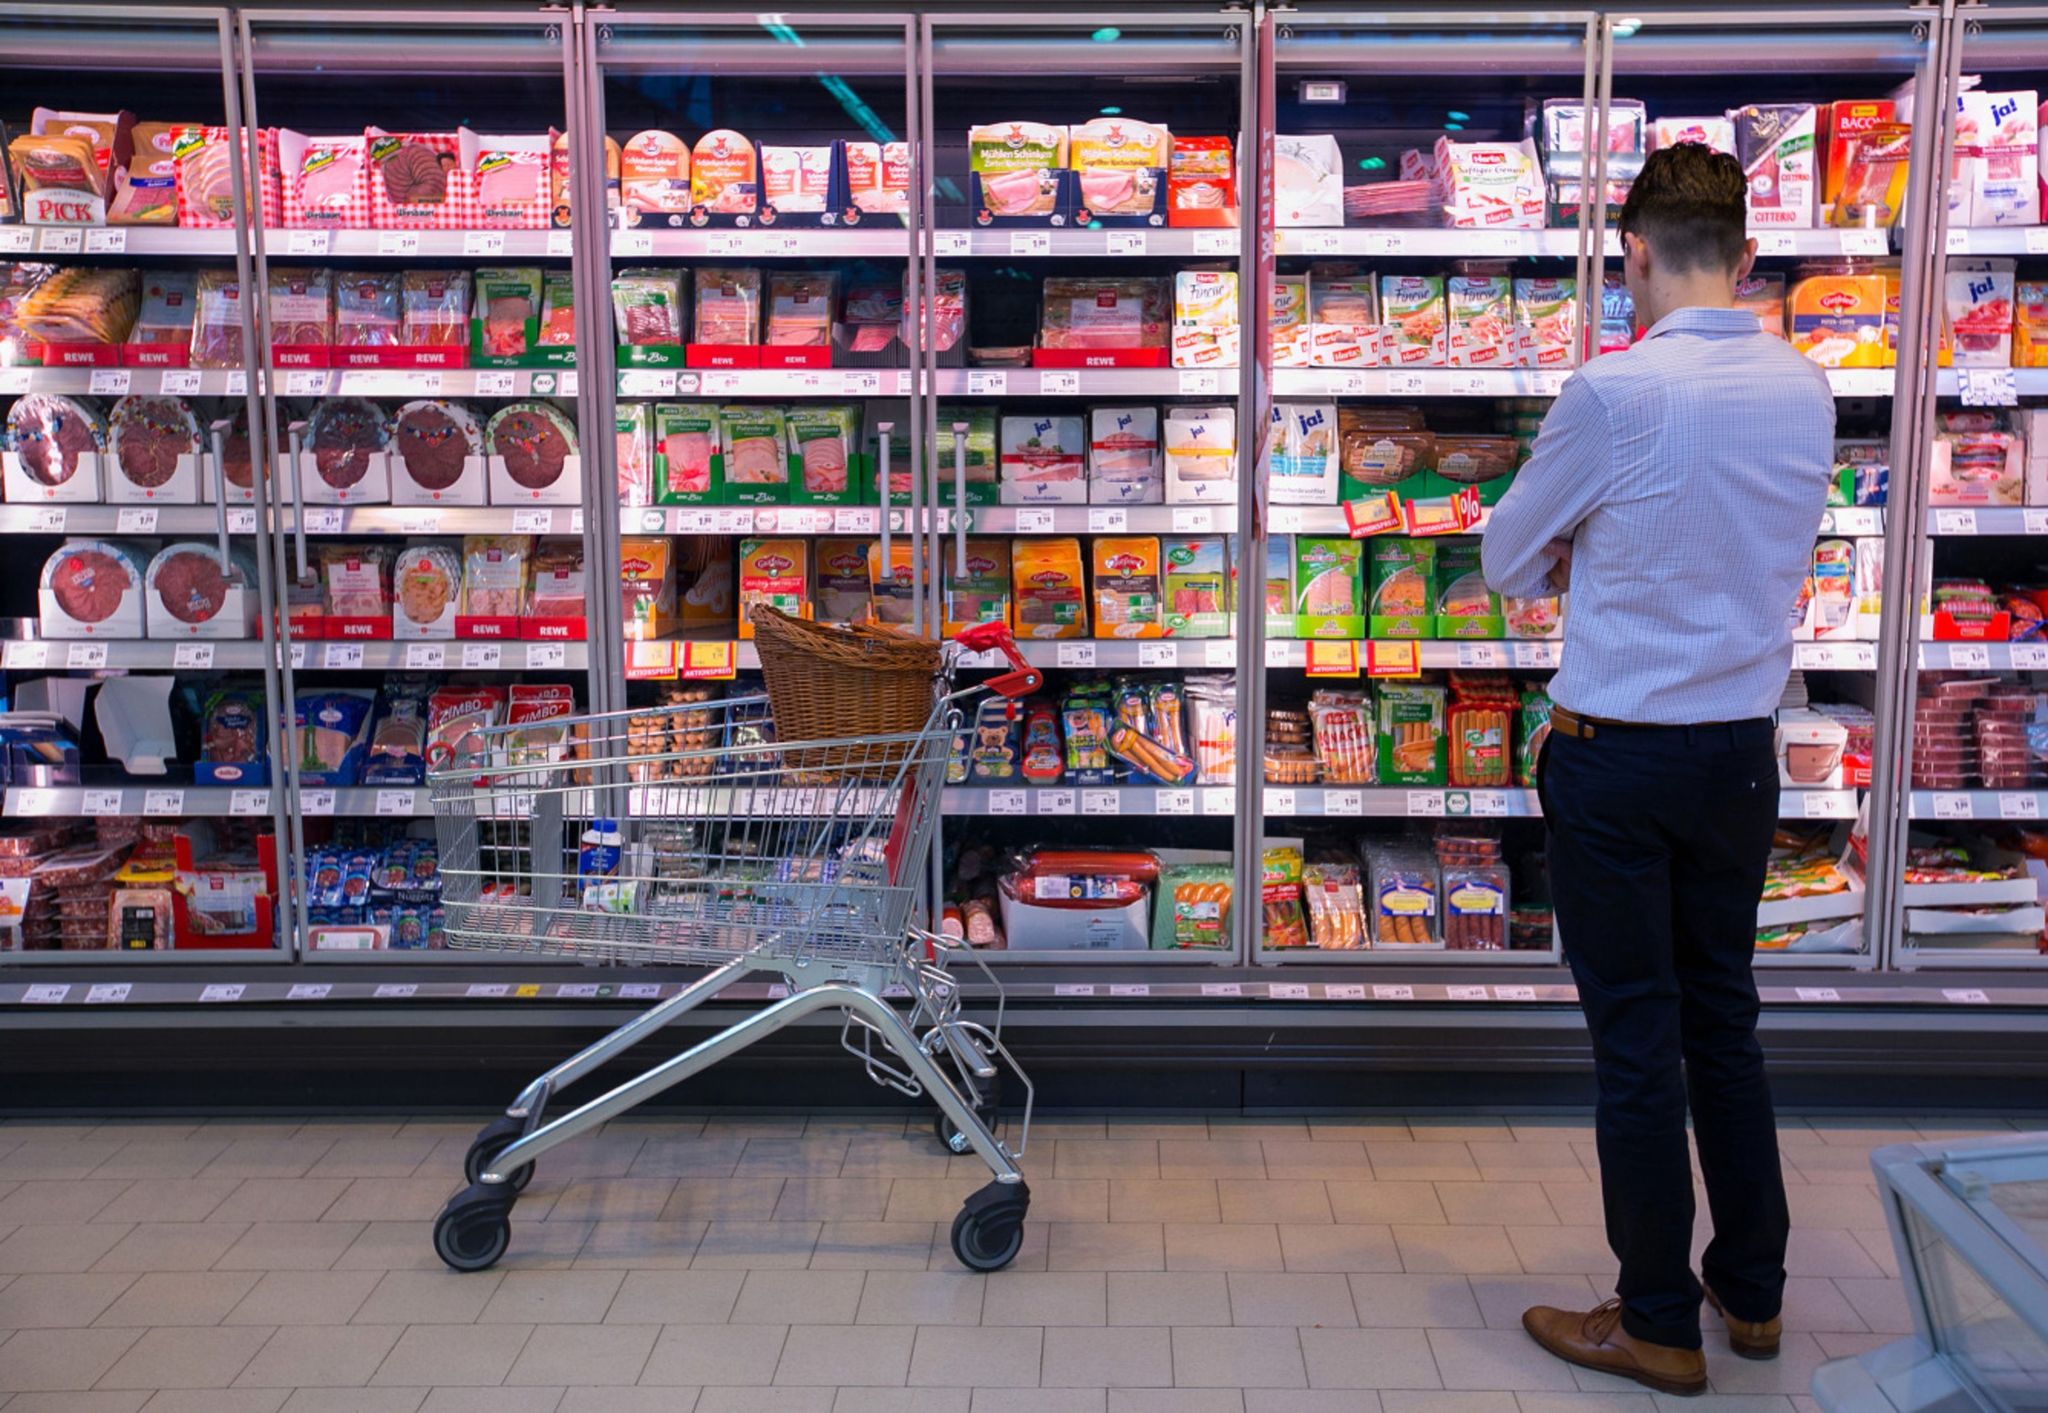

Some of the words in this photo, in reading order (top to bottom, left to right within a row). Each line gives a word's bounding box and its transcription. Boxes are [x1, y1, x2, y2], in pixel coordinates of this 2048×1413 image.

[1990, 98, 2017, 127] ja!
[37, 199, 92, 223] PICK
[1755, 211, 1797, 223] CITTERIO
[1968, 277, 1995, 304] ja!
[64, 353, 95, 363] REWE
[139, 353, 169, 363] REWE
[280, 353, 311, 363] REWE
[349, 354, 380, 364] REWE
[416, 353, 445, 363] REWE
[648, 352, 669, 362] Bio
[1086, 357, 1115, 366] REWE
[1540, 351, 1564, 362] Herta
[1117, 414, 1133, 430] ja!
[1300, 409, 1325, 436] ja!
[1033, 419, 1053, 438] ja!
[1190, 425, 1206, 439] ja!
[755, 492, 776, 502] Bio
[344, 625, 373, 635] REWE
[472, 625, 501, 634] REWE
[540, 626, 569, 636] REWE
[685, 667, 732, 678] AKTIONSPREIS
[439, 700, 482, 723] ZIMBO
